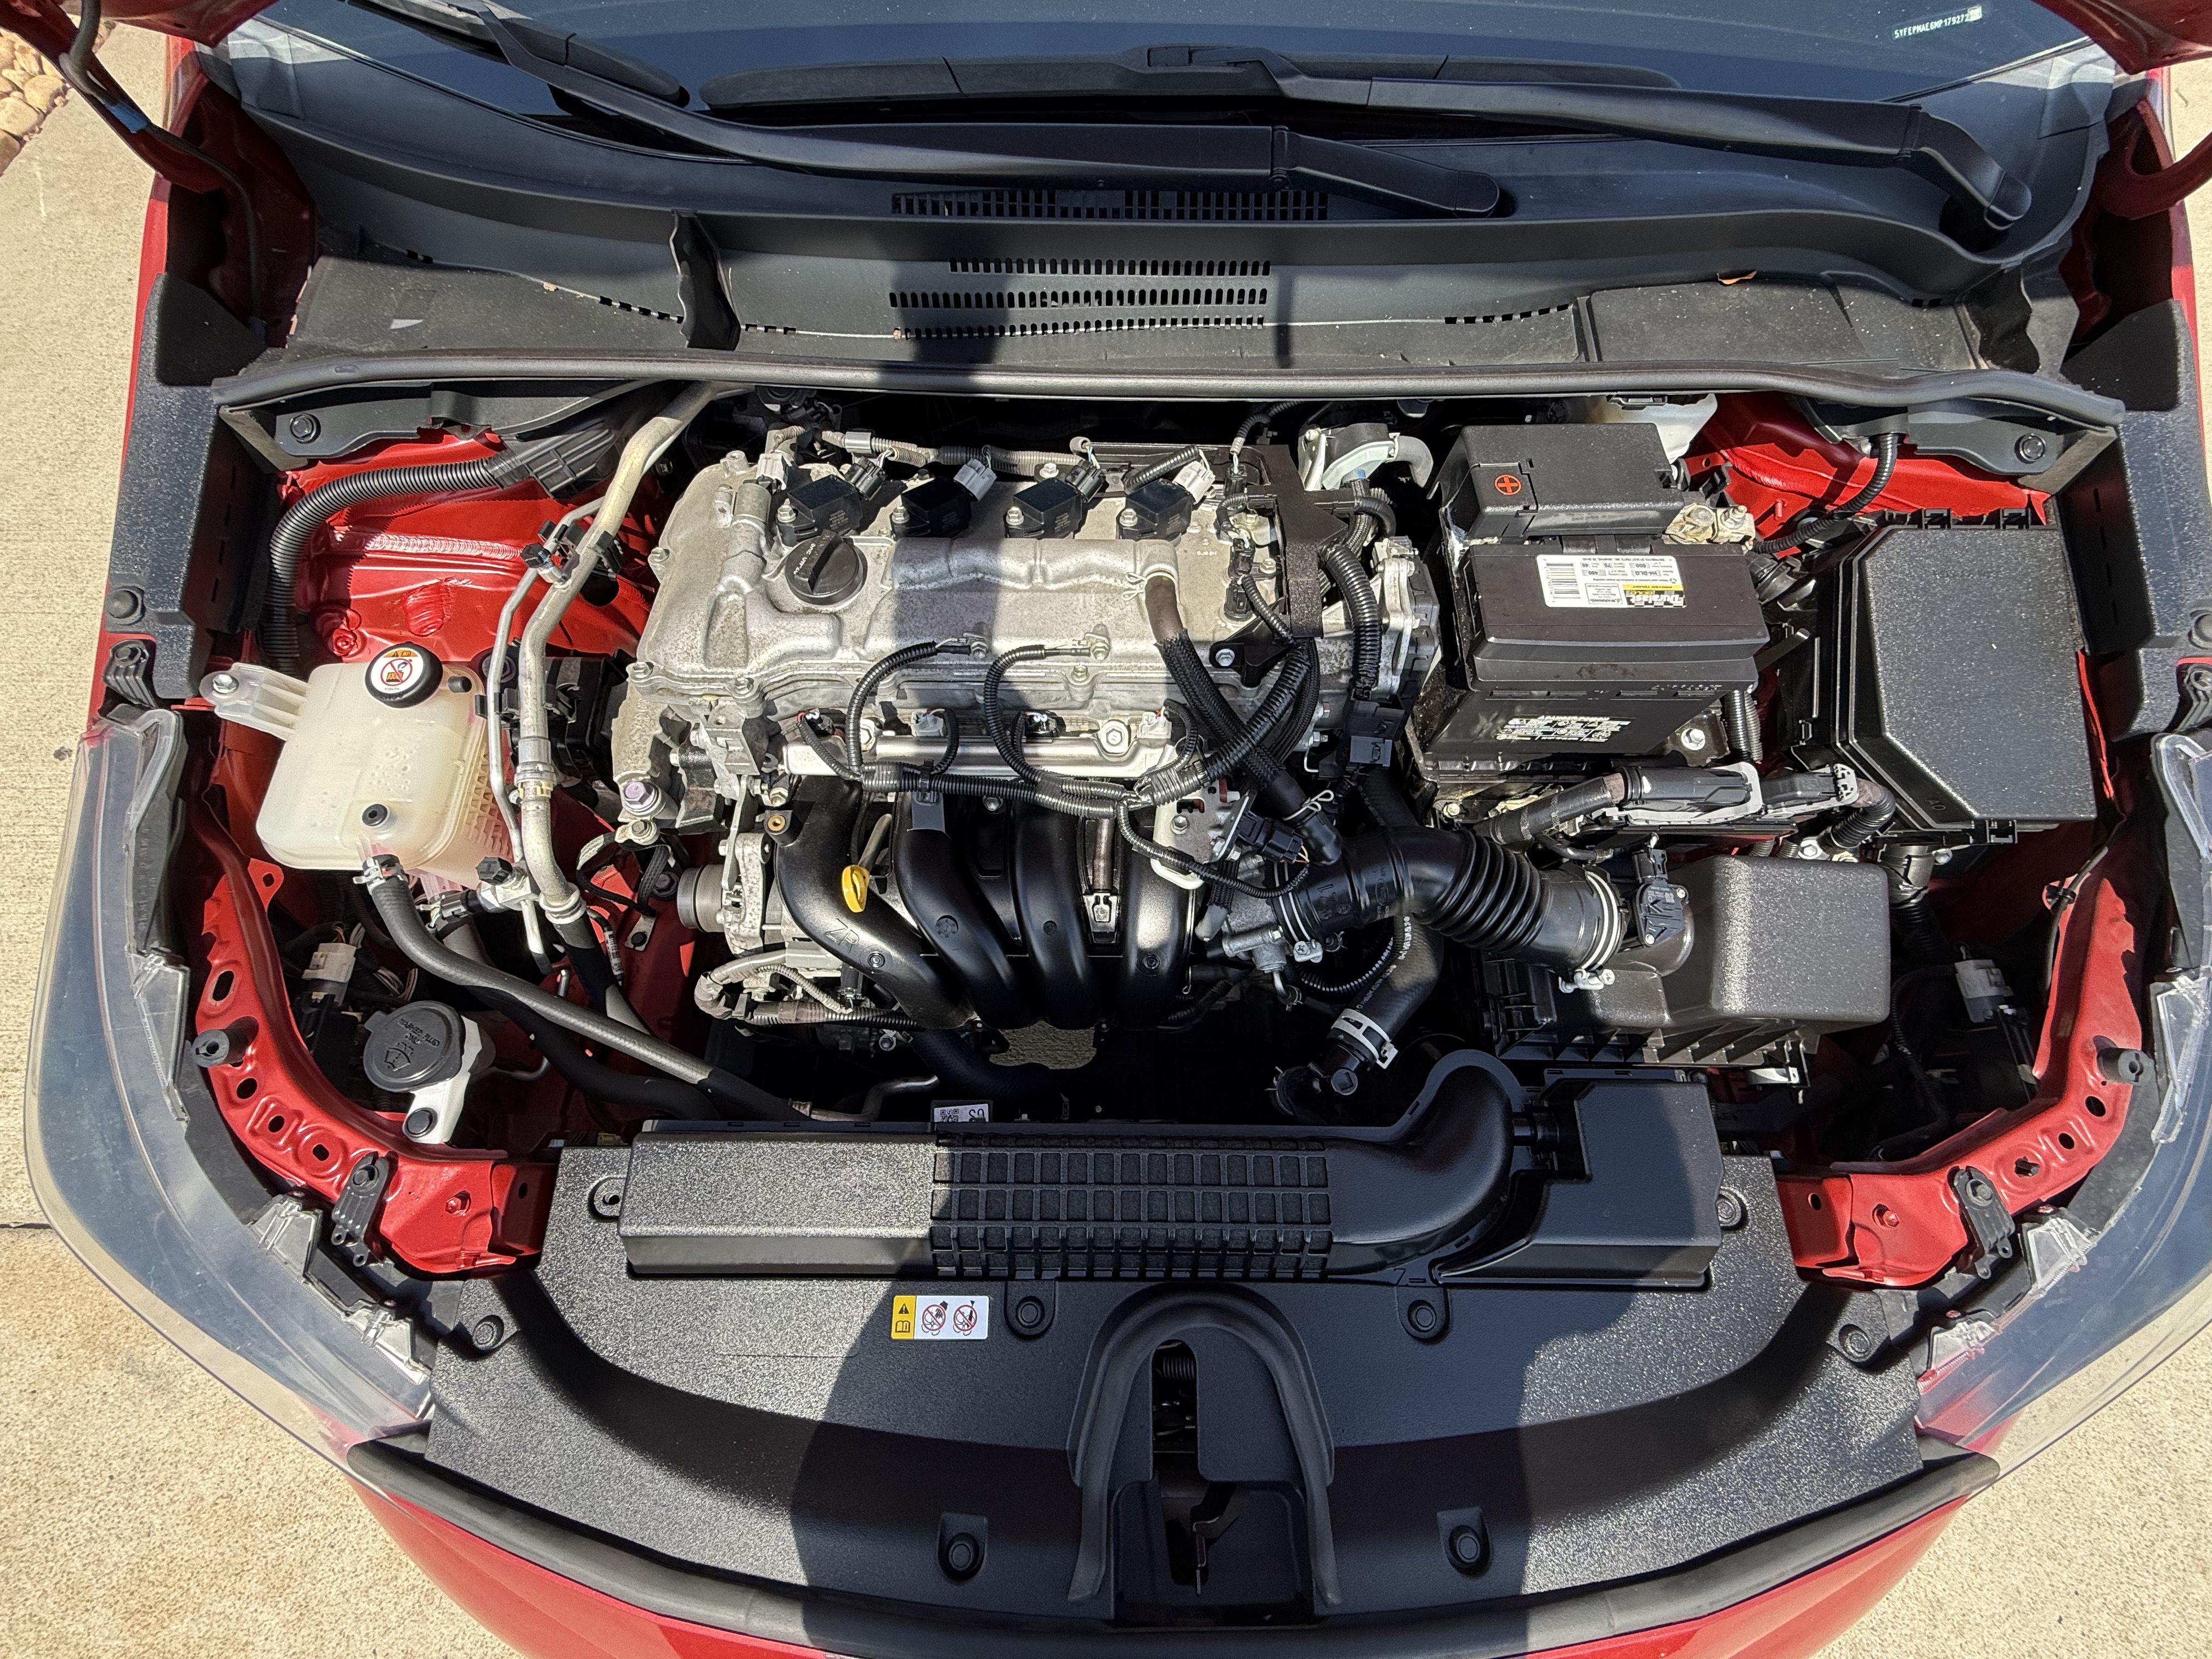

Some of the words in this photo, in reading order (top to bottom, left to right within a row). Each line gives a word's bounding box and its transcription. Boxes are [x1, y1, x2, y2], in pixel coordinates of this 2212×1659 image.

[1630, 594, 1684, 604] Duralast
[398, 1018, 424, 1036] WASHER
[421, 1032, 441, 1047] FLUID
[405, 1032, 422, 1045] ONLY
